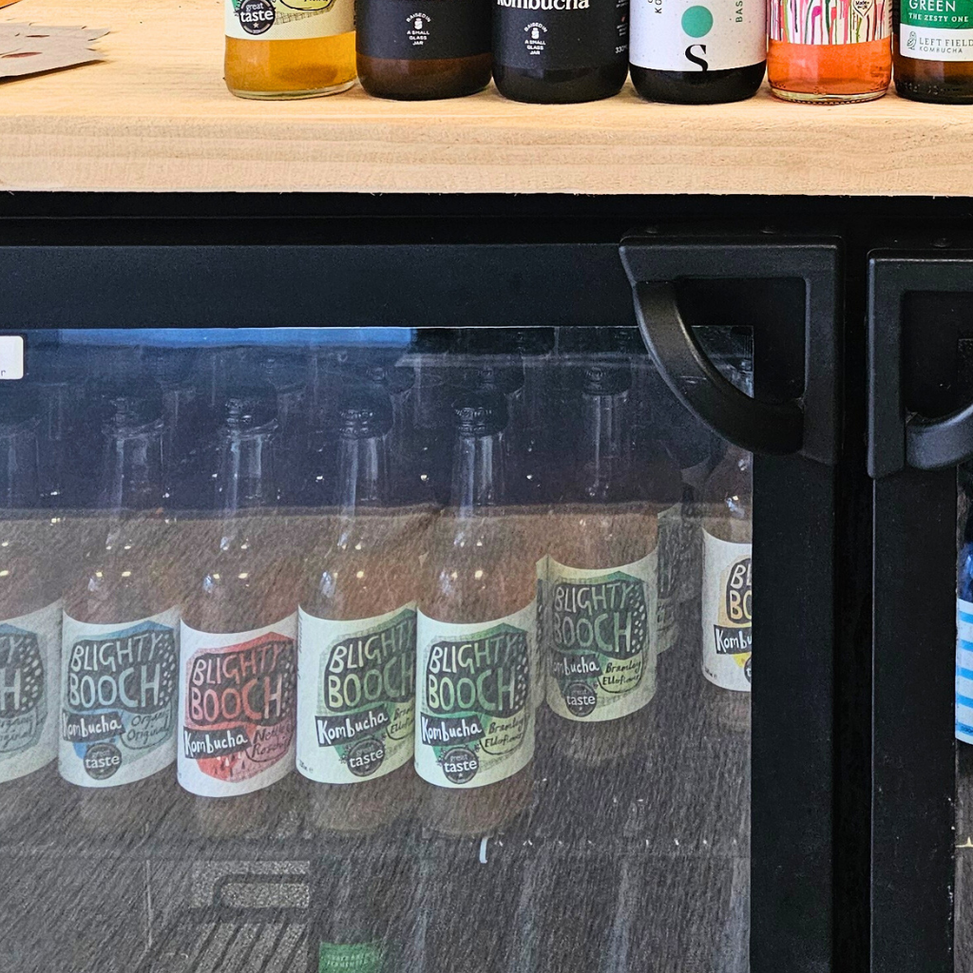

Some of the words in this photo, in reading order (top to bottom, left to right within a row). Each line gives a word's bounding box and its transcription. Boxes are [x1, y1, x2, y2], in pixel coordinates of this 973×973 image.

[240, 7, 274, 22] taste
[909, 12, 922, 21] THE
[924, 14, 948, 22] ZESTY
[951, 15, 969, 23] ONE
[919, 37, 943, 46] LEFT
[919, 46, 963, 54] KOMBUCHA
[554, 582, 633, 615] BLIGHTY
[553, 612, 632, 653] BOOCH
[71, 633, 163, 672] BLIGHTY
[193, 645, 280, 686] BLIGHTY
[429, 634, 518, 673] BLIGHTY
[69, 664, 160, 707] BOOCH
[329, 652, 414, 708] BOOCH
[428, 666, 516, 711] BOOCH
[192, 674, 282, 721] BOOCH
[567, 694, 595, 705] taste
[317, 711, 388, 744] Kombucha
[421, 717, 482, 744] Kombucha
[185, 731, 247, 755] Kombucha
[85, 754, 120, 768] taste
[350, 749, 384, 768] taste
[444, 758, 477, 773] taste
